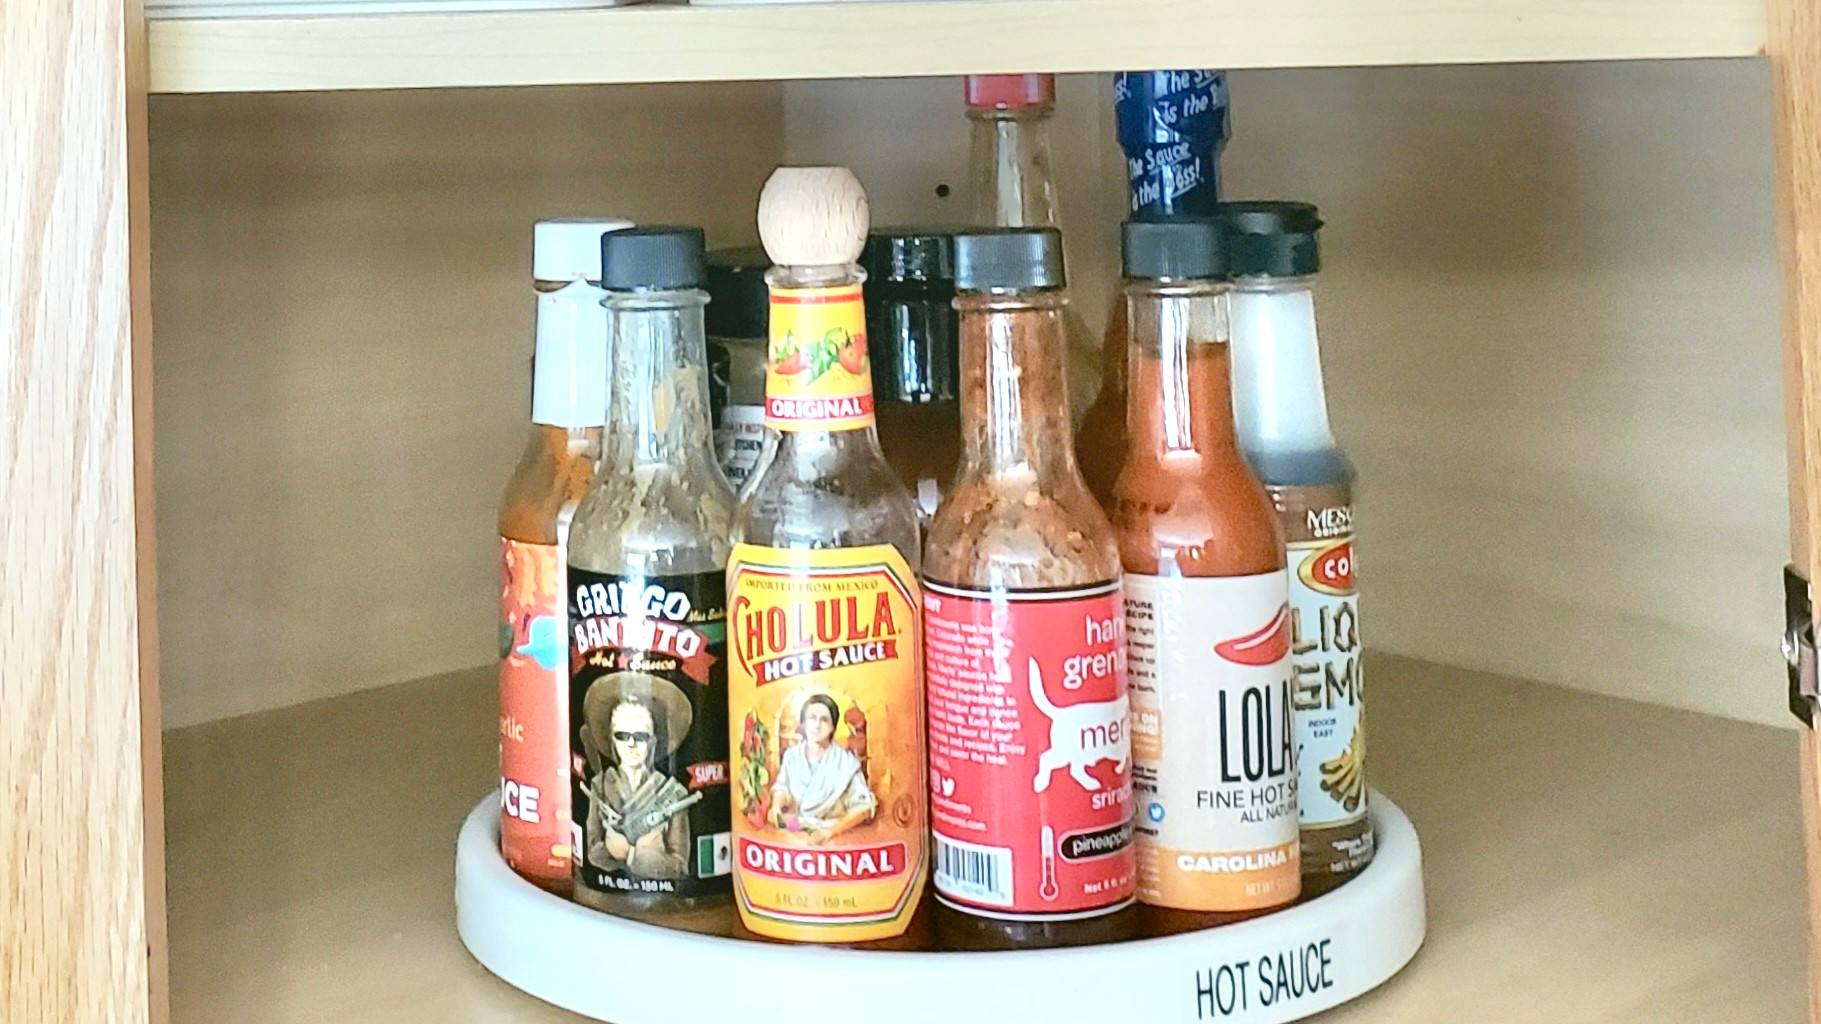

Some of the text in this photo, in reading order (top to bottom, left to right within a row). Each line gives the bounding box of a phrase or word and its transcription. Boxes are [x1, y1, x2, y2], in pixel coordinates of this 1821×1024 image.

[1183, 94, 1209, 117] the
[1145, 142, 1191, 171] Sauce
[1139, 180, 1161, 207] the
[771, 398, 863, 419] ORIGINAL
[746, 578, 879, 593] IMPORTED FROM MEXICO
[733, 591, 896, 678] CHOLULA
[630, 652, 676, 675] Sauce
[764, 641, 886, 682] HOT SAUCE
[695, 763, 724, 783] SUPER
[1197, 789, 1245, 809] FINE
[1250, 782, 1285, 807] HOT
[1240, 807, 1263, 824] ALL
[745, 844, 894, 877] ORIGINAL
[1176, 849, 1287, 874] CAROLINA
[823, 896, 840, 908] 150
[1195, 938, 1334, 1020] HOT SAUCE
